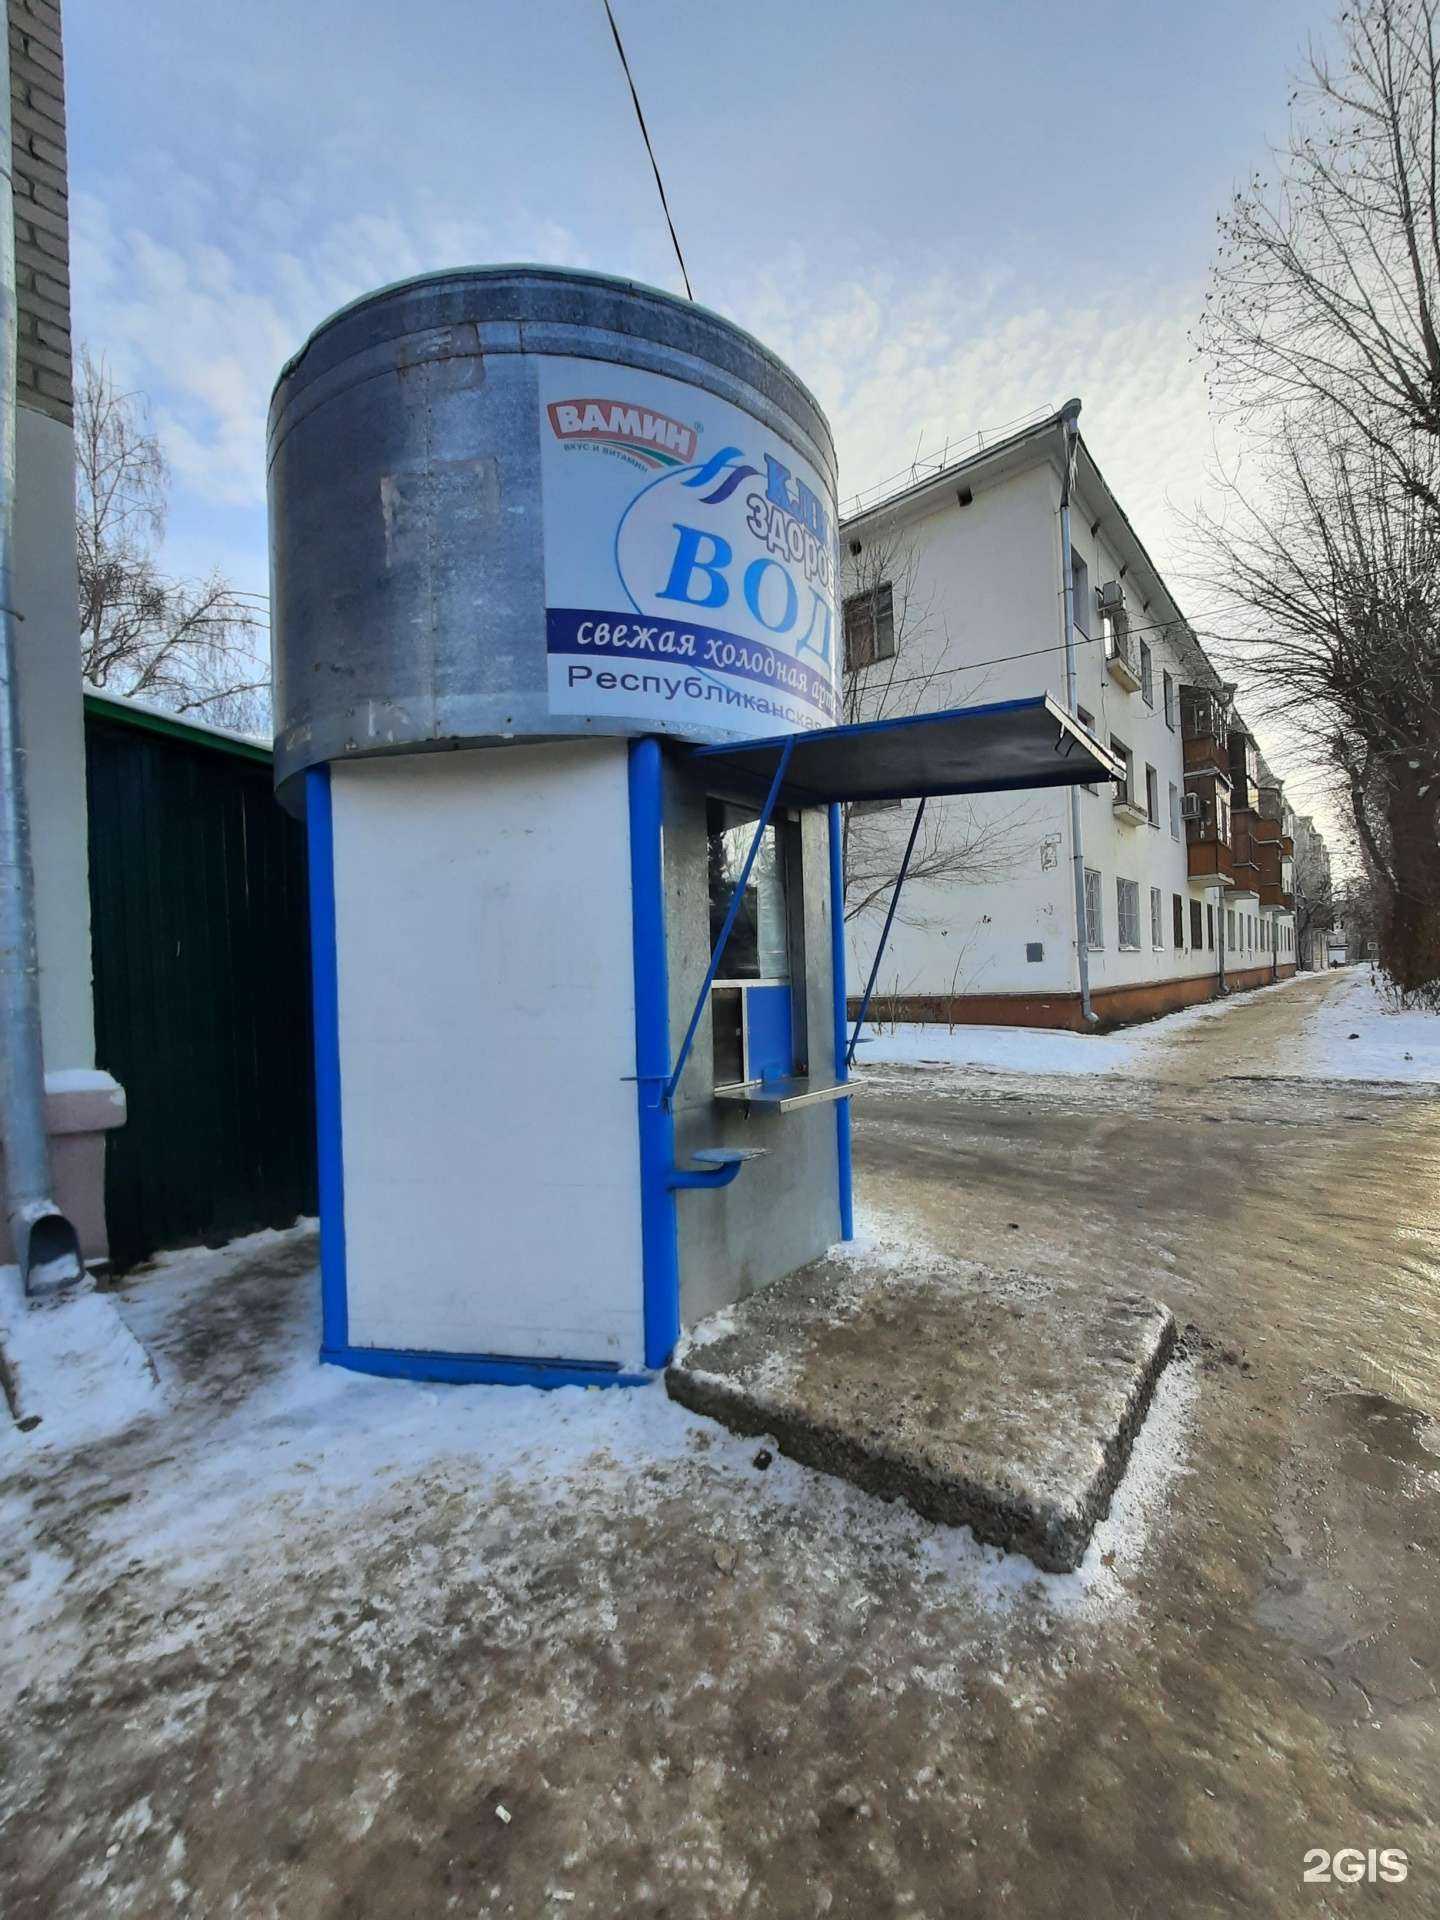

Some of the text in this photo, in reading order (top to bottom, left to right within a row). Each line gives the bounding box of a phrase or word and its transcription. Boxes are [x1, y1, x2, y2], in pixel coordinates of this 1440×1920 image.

[556, 404, 691, 454] ВАМИН
[564, 443, 590, 453] ВКУС
[577, 621, 835, 712] свежая холодная арт
